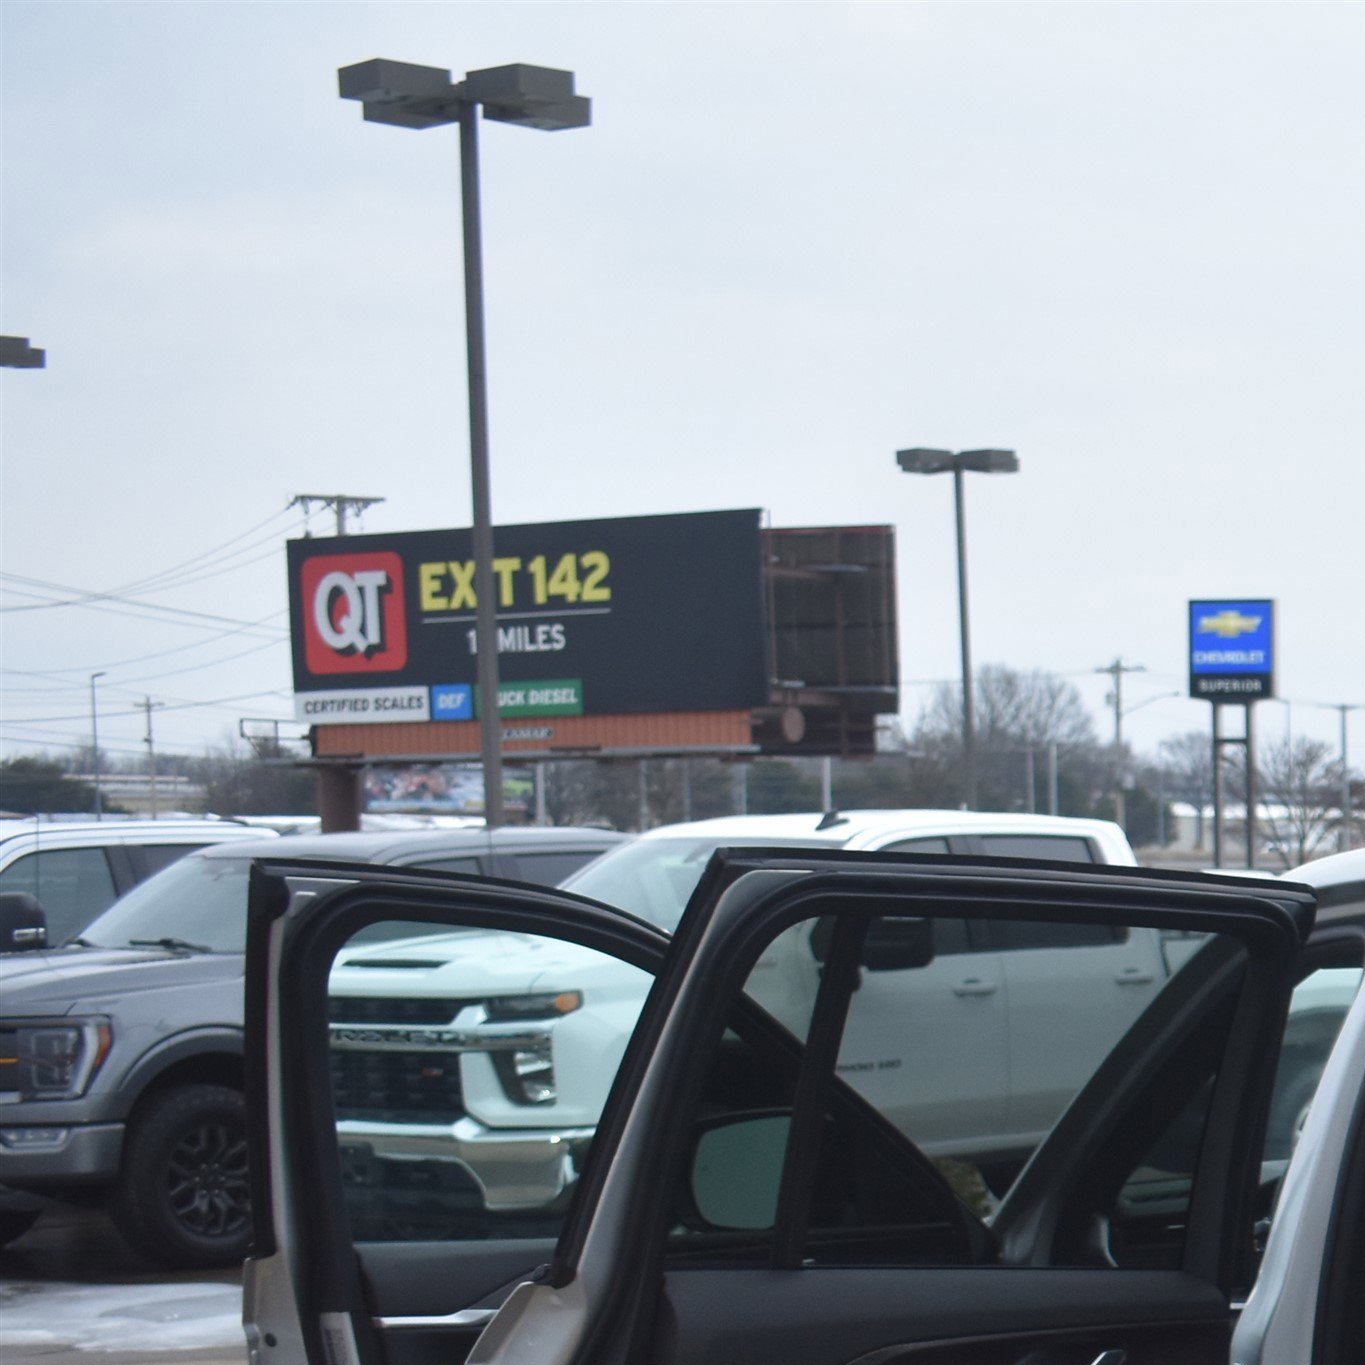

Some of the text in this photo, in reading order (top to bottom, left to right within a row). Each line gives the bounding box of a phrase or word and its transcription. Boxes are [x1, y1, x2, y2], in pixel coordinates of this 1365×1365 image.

[418, 551, 612, 612] EXT 142
[314, 570, 388, 653] QT
[497, 622, 567, 653] MILES
[1193, 650, 1266, 665] CHEVROLET
[1198, 678, 1262, 693] SUPERIOR
[304, 695, 424, 715] CERTIFIED SCALES
[438, 692, 467, 710] DEF
[497, 687, 579, 708] UCK DIESEL
